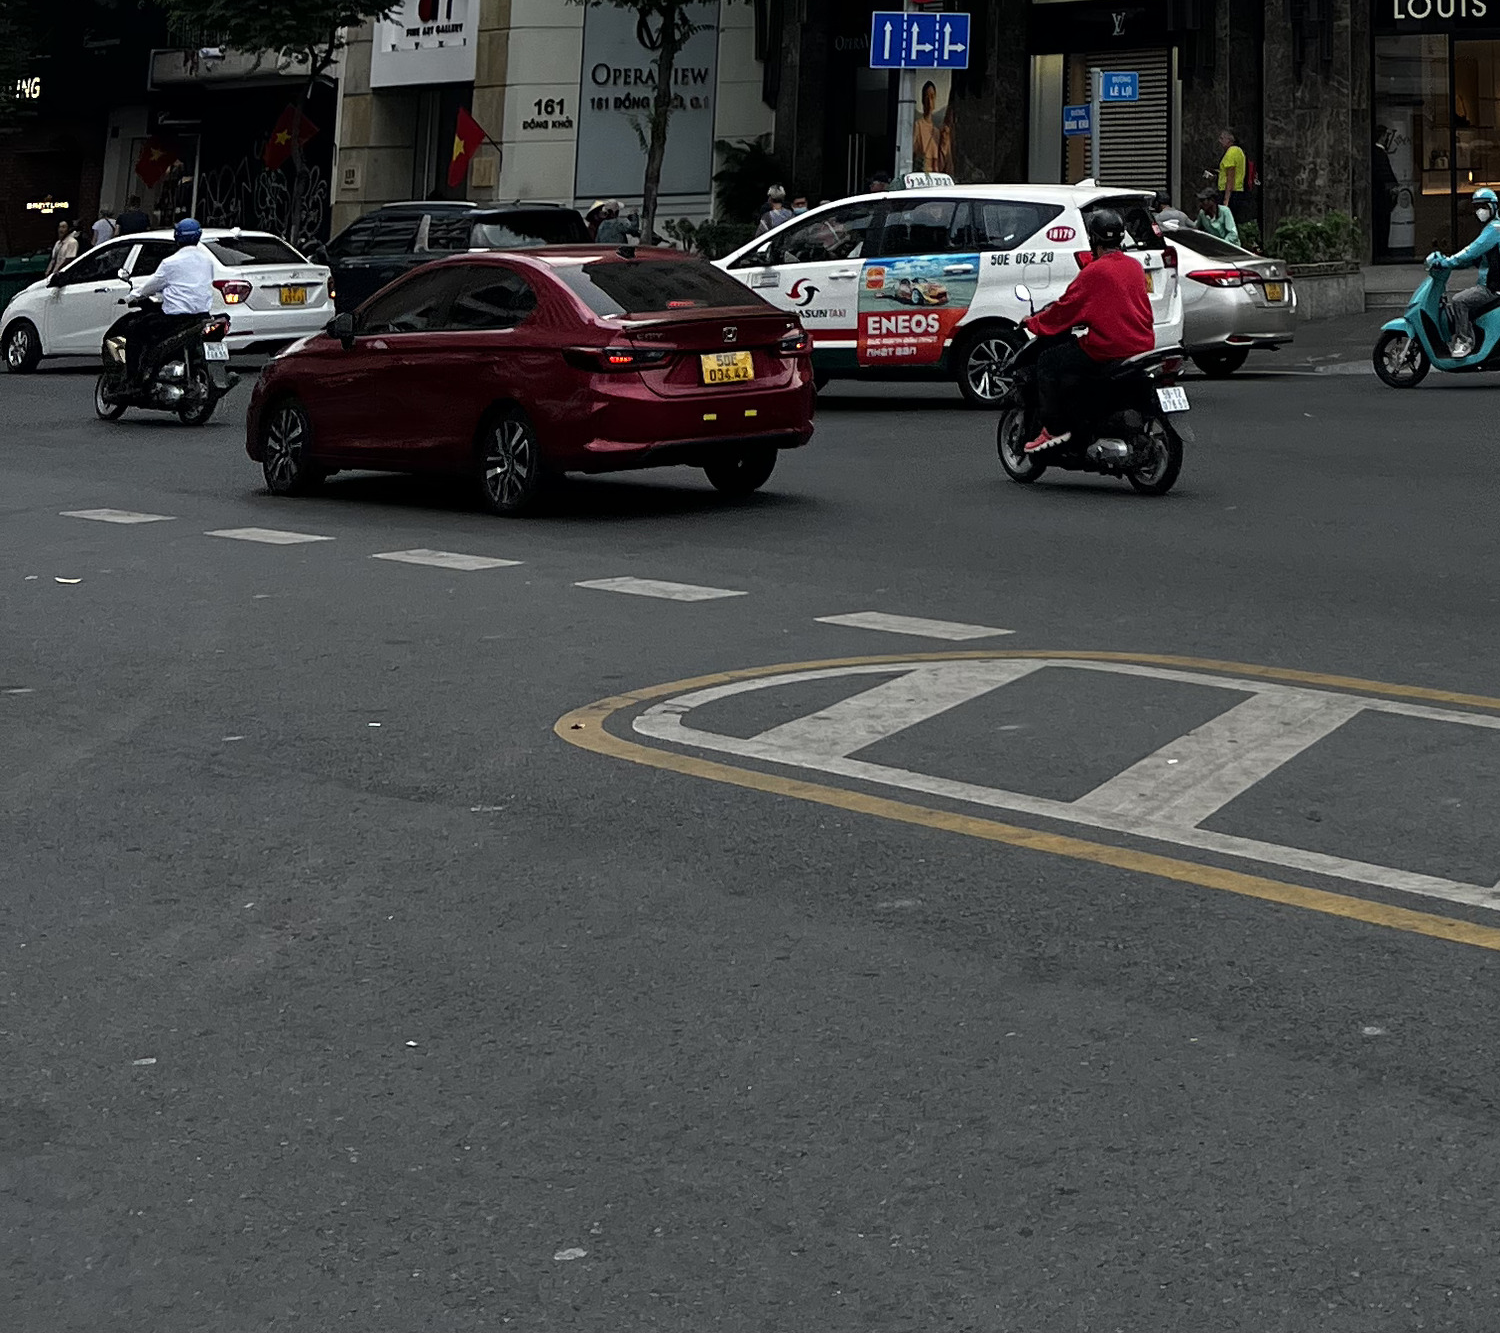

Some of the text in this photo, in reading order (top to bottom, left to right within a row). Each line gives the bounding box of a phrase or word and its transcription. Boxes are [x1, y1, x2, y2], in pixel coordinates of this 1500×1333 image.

[591, 63, 708, 86] OPERAIEW
[534, 98, 565, 116] 161
[590, 97, 609, 110] 161
[991, 253, 1010, 266] 50E
[867, 313, 940, 335] ENEOS
